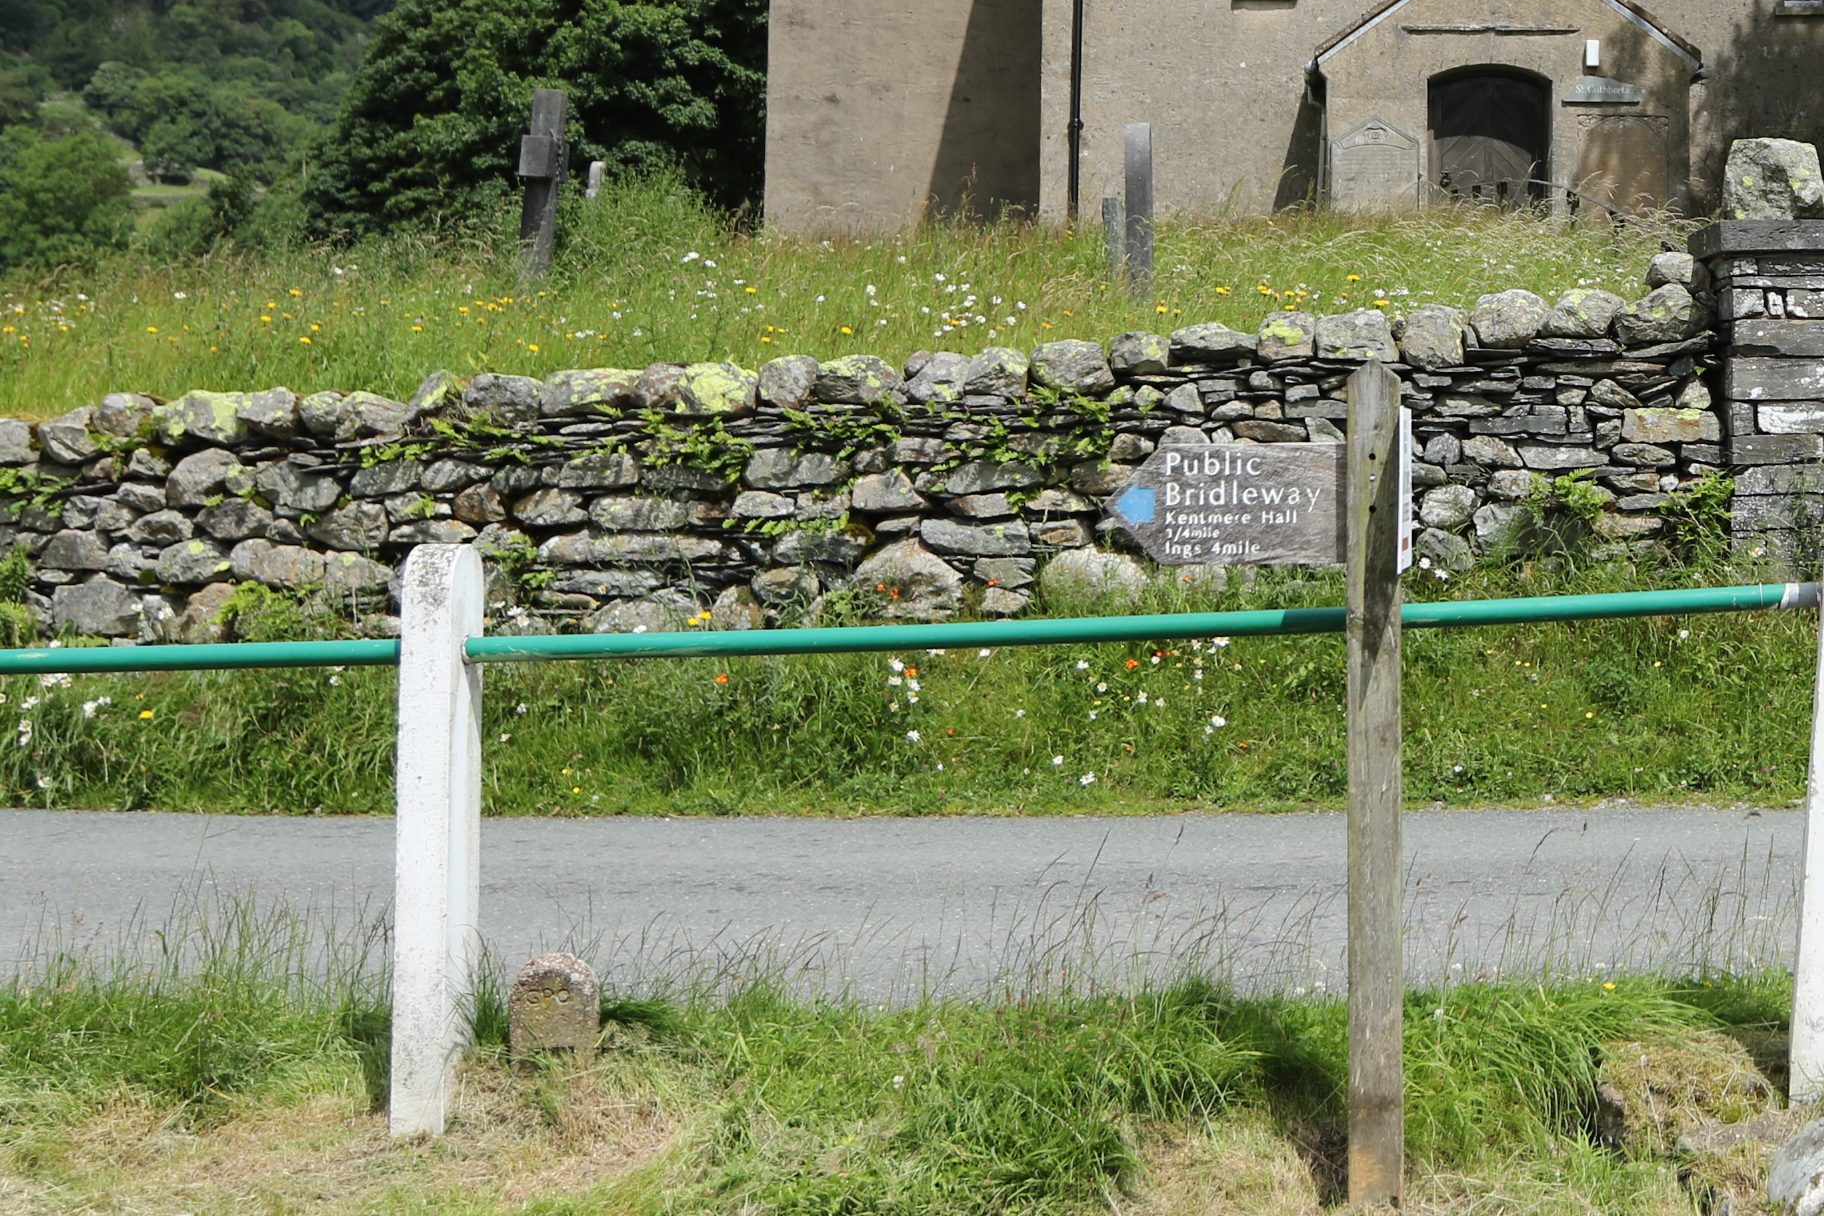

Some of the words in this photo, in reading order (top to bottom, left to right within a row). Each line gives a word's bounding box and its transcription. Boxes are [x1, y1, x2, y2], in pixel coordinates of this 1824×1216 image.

[1165, 450, 1261, 476] Public
[1165, 479, 1321, 513] Bridleway
[1165, 510, 1251, 524] Kentmere
[1261, 509, 1297, 524] Hall
[1165, 540, 1202, 559] Ings
[1211, 540, 1260, 555] 4mile
